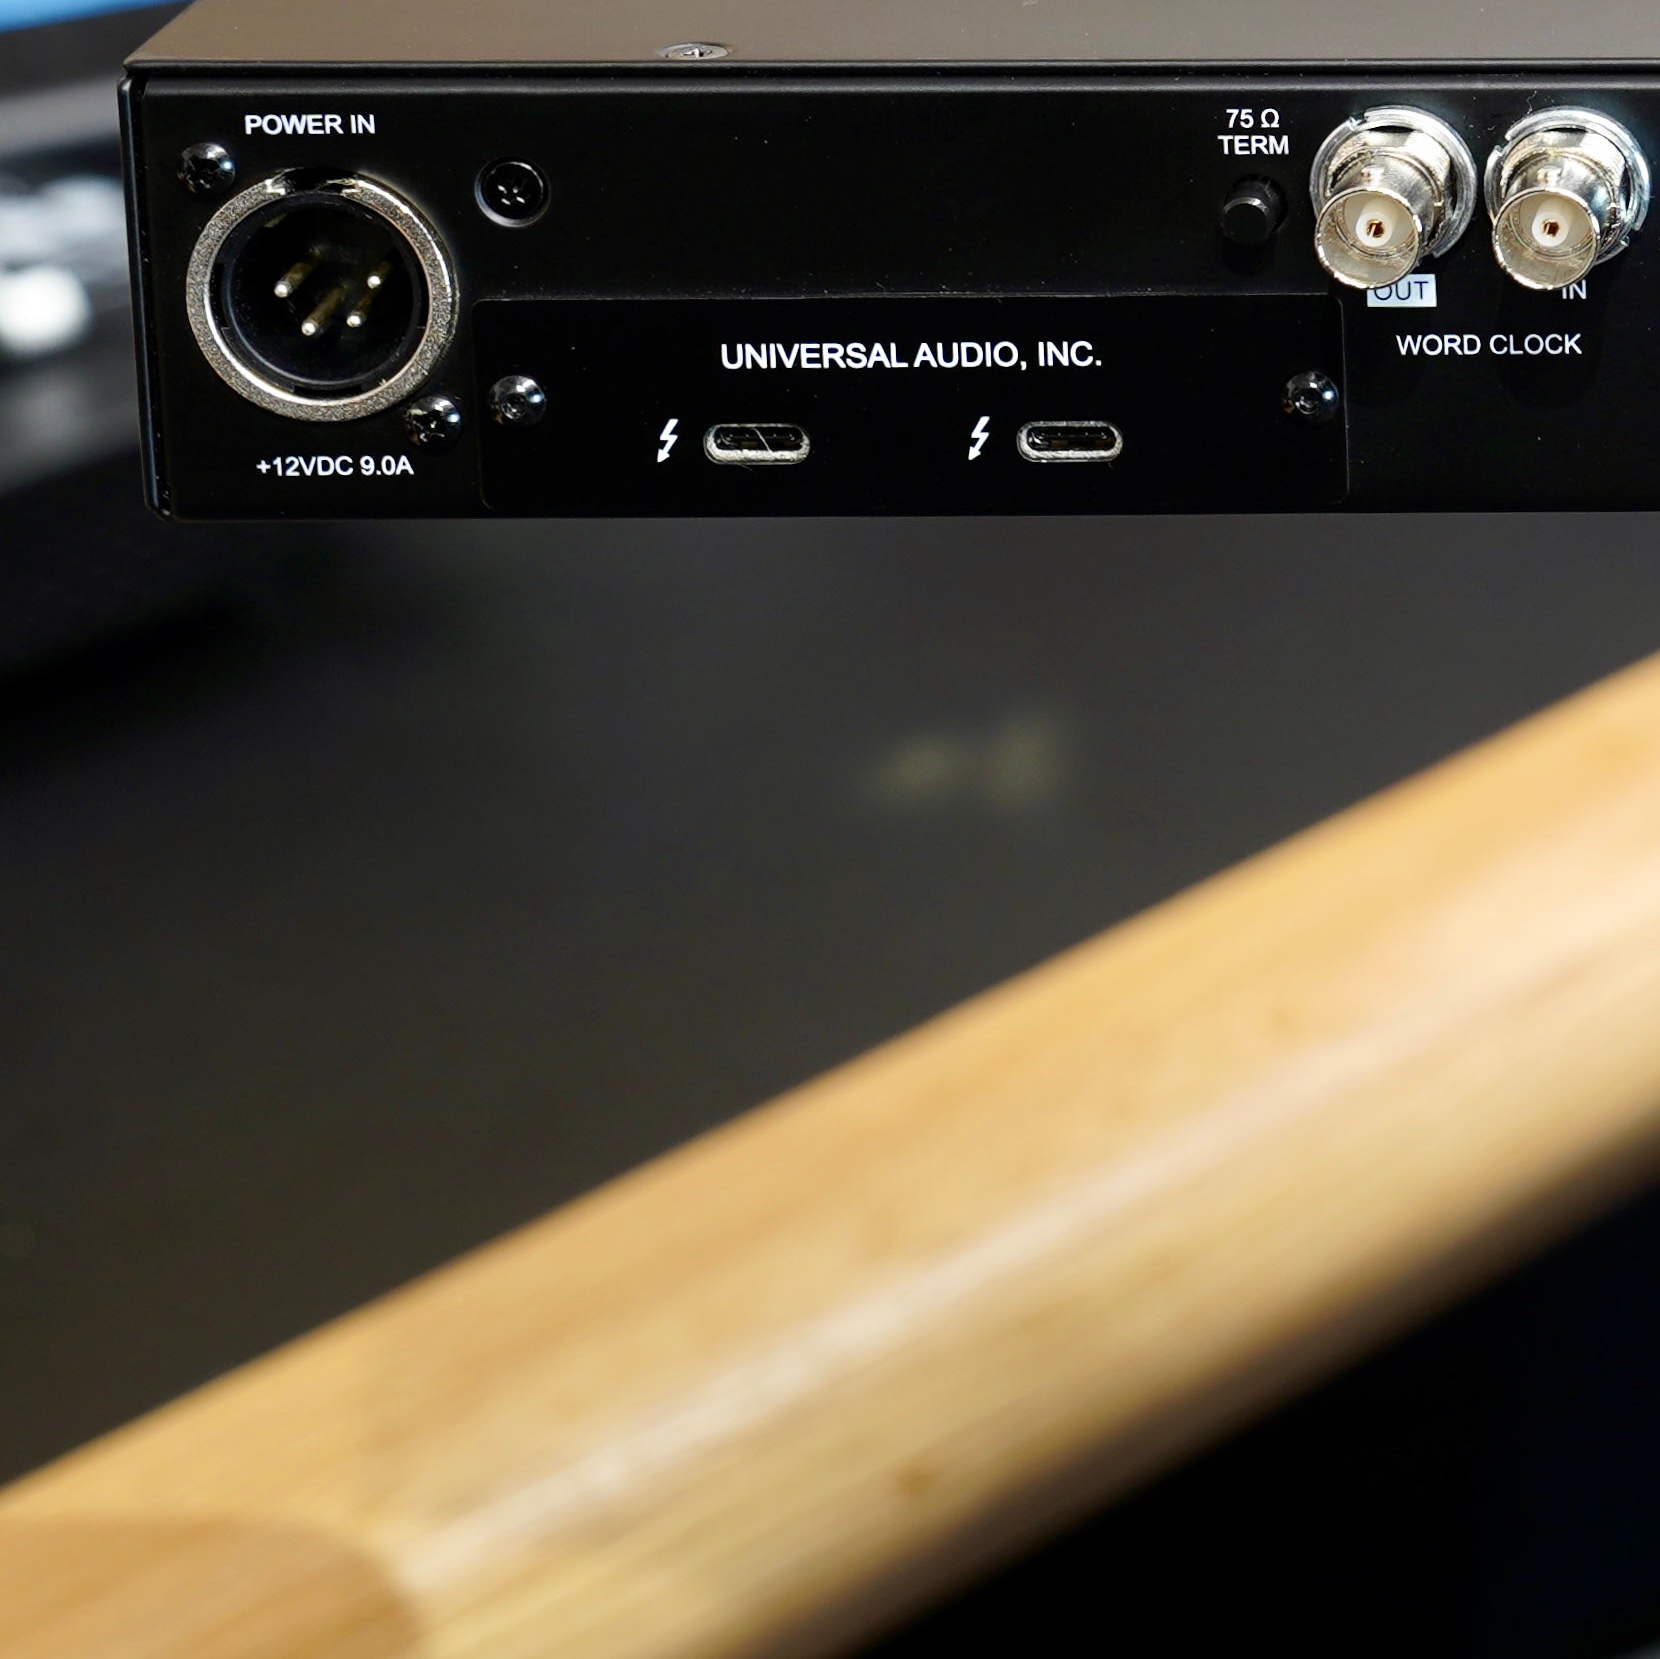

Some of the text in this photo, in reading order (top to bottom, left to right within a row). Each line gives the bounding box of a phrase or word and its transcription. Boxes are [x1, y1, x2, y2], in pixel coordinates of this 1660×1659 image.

[244, 113, 376, 136] POWER IN
[1225, 108, 1255, 129] 75
[1217, 134, 1290, 156] TERM
[1561, 280, 1587, 300] IN
[721, 340, 1102, 371] UNIVERSAL AUDIO, INC.
[1395, 333, 1583, 356] WORD CLOCK
[256, 454, 415, 477] +12VDC 9.0A
